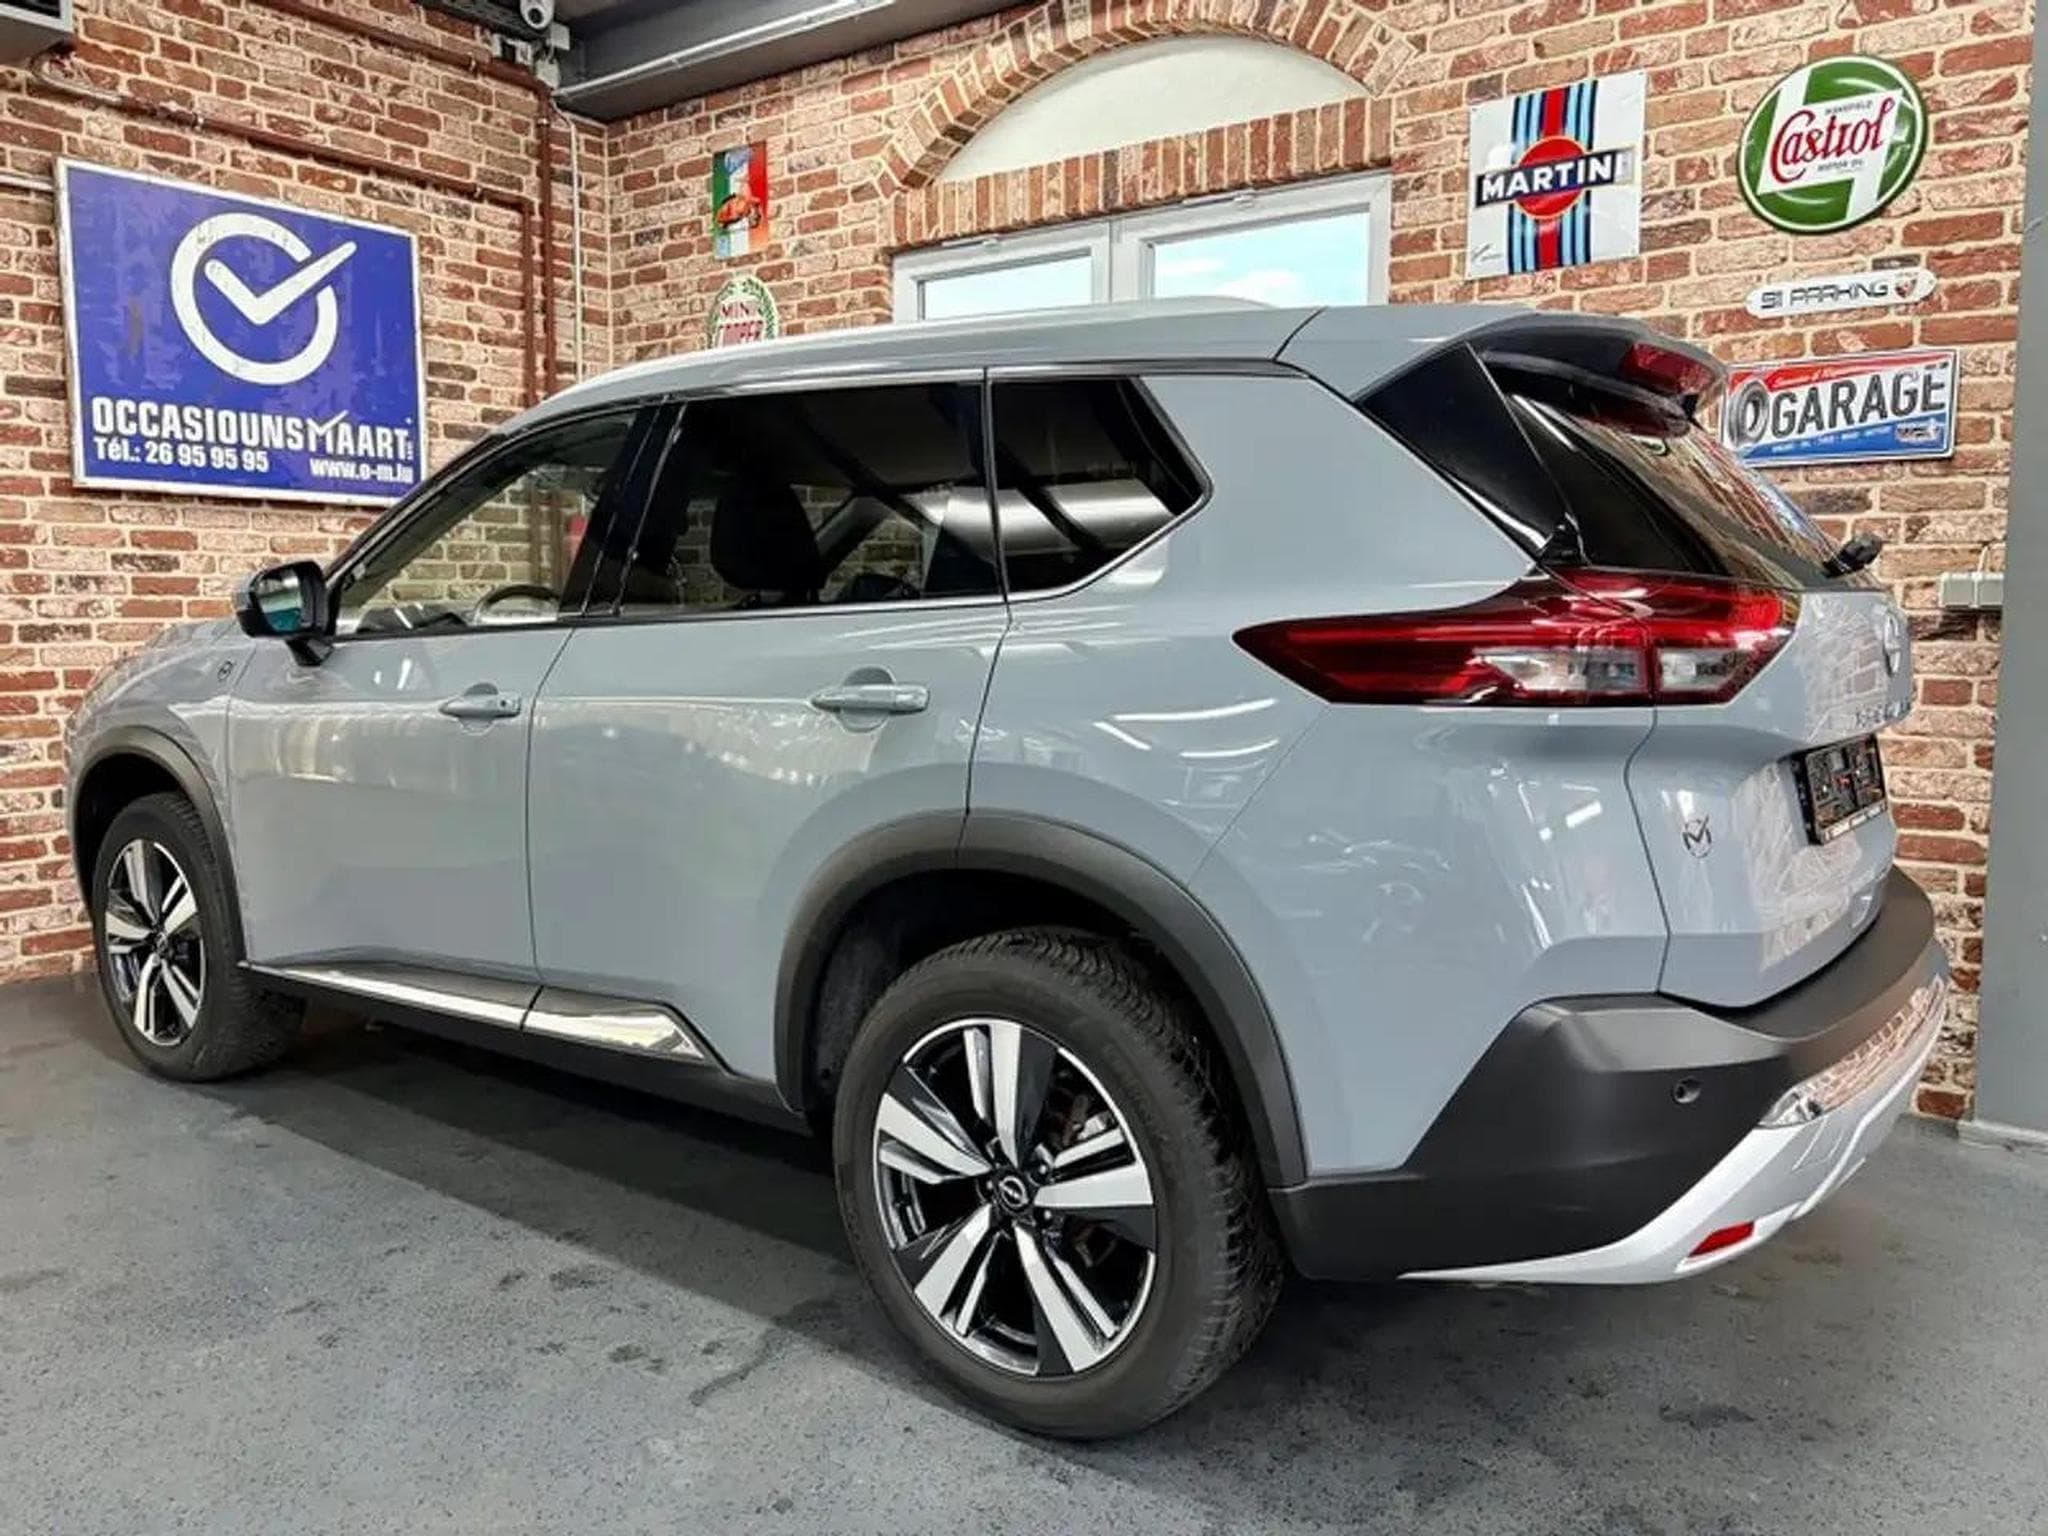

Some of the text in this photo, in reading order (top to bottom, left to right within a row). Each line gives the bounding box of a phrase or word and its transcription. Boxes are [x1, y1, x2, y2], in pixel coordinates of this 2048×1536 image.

[1770, 97, 1895, 184] Castrol
[1482, 153, 1624, 202] MARTINI
[1790, 280, 1889, 307] PARKING
[1771, 362, 1949, 438] GARAGE
[144, 440, 174, 465] 26
[177, 443, 207, 467] 95
[210, 446, 238, 470] 95
[241, 449, 269, 473] 95
[309, 457, 414, 485] www.o-m.lu
